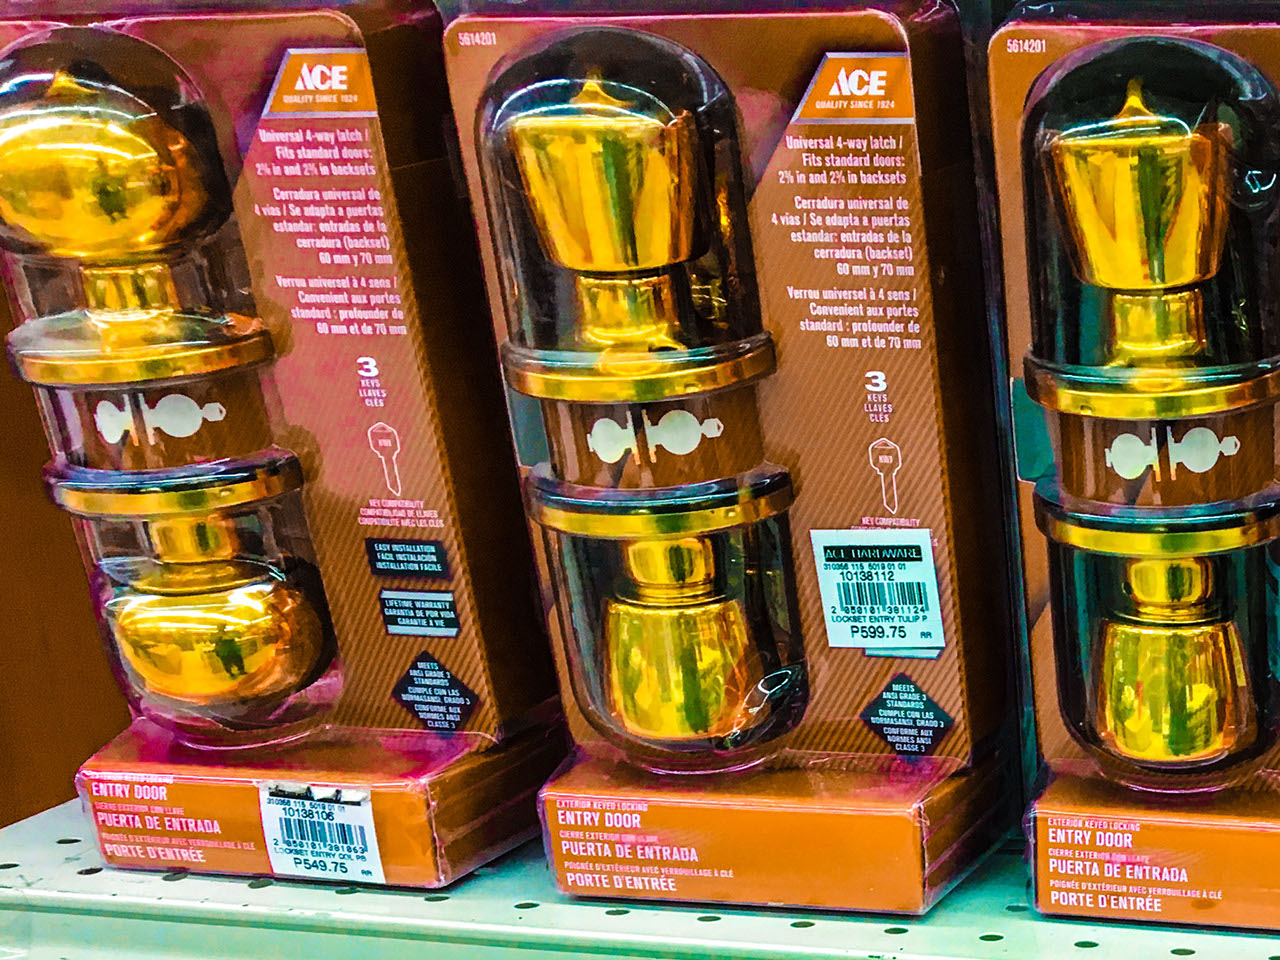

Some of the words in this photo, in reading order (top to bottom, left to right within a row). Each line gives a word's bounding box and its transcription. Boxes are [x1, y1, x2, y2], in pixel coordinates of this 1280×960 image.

[458, 32, 497, 46] 5614201
[1006, 38, 1047, 53] 5614201
[295, 63, 347, 91] ACE
[829, 67, 887, 96] ACE
[357, 356, 379, 376] 3
[865, 370, 887, 391] 3
[840, 571, 894, 581] 10138112
[851, 626, 906, 638] P599.75
[92, 783, 129, 799] ENTRY
[134, 786, 167, 801] DOOR
[98, 812, 142, 829] PUERTA
[146, 817, 162, 830] DE
[165, 818, 222, 834] ENTRADA
[281, 807, 335, 822] 10138106
[557, 811, 600, 826] ENTRY
[605, 814, 641, 828] DOOR
[1048, 818, 1083, 828] EXTERIOR
[1084, 820, 1108, 829] KEYED
[1109, 822, 1140, 831] LOCKING
[1048, 829, 1091, 845] ENTRY
[1096, 832, 1133, 848] DOOR
[104, 844, 142, 859] PORTE
[146, 844, 206, 863] D'ENTRÉE
[561, 840, 612, 857] PUERTA
[616, 844, 633, 858] DE
[638, 845, 699, 862] ENTRADA
[294, 857, 349, 874] P549.75
[1049, 858, 1100, 876] PUERTA
[1104, 863, 1121, 878] DE
[1126, 865, 1188, 882] ENTRADA
[567, 873, 610, 888] PORTE
[614, 874, 677, 891] D'ENTRÉE
[1051, 891, 1094, 907] PORTE
[1098, 895, 1162, 912] D'ENTRÉE
